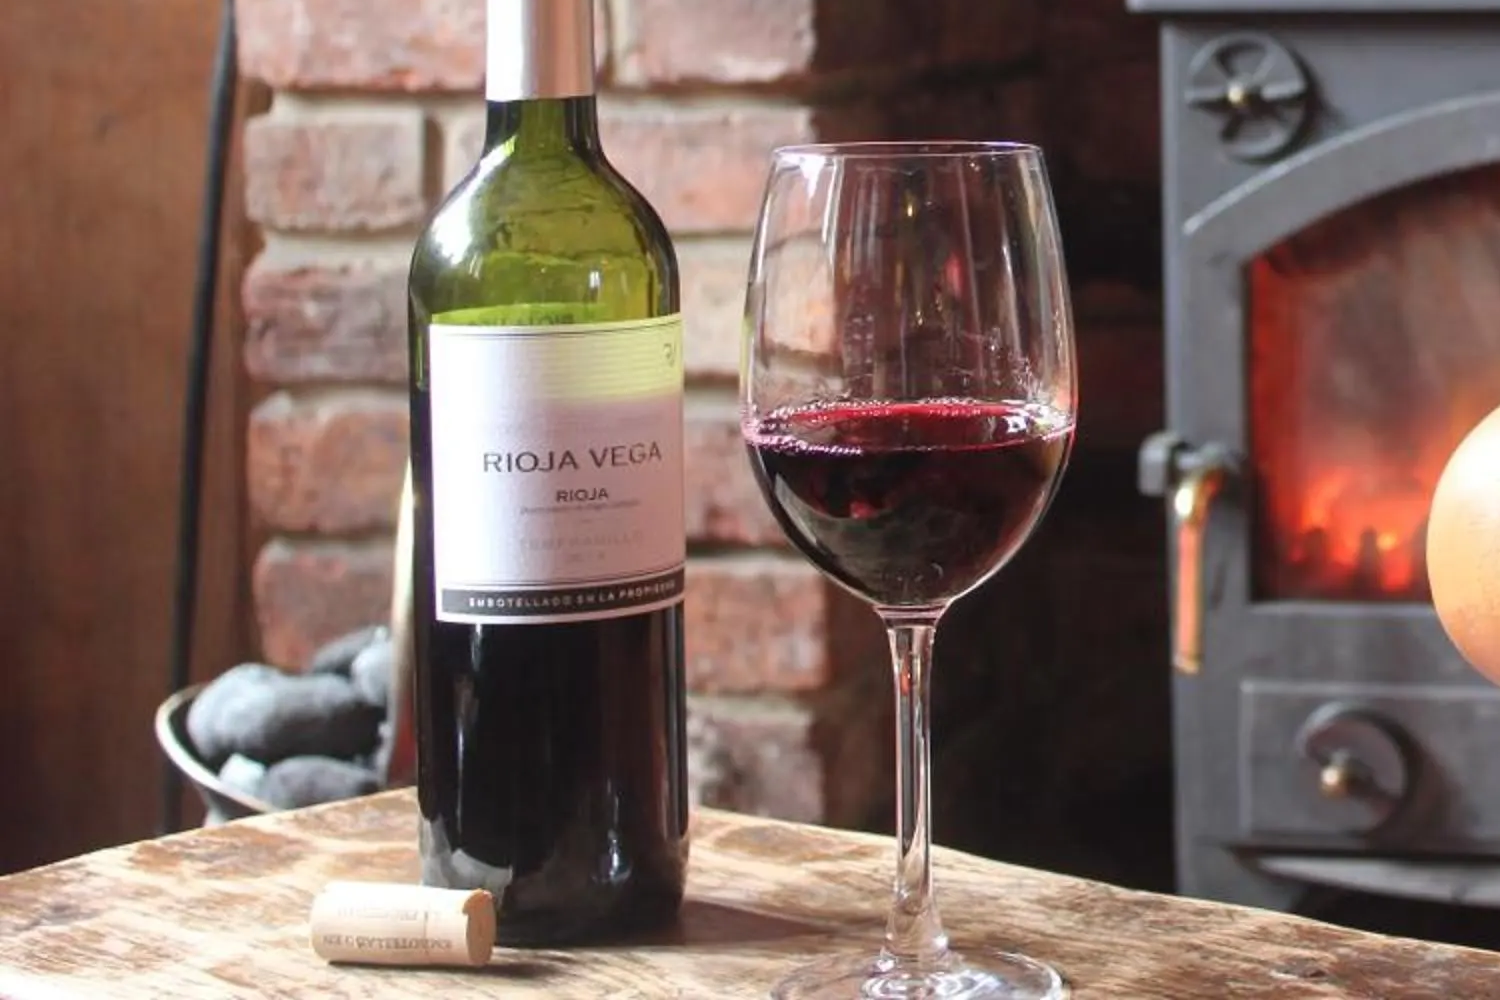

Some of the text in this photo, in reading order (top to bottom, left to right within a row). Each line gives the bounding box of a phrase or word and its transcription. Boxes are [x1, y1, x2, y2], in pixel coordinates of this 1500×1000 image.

[482, 441, 664, 473] RIOJA VEGA
[555, 487, 610, 503] RIOJA
[468, 594, 572, 609] EMBOTELLADO
[598, 592, 615, 603] LA
